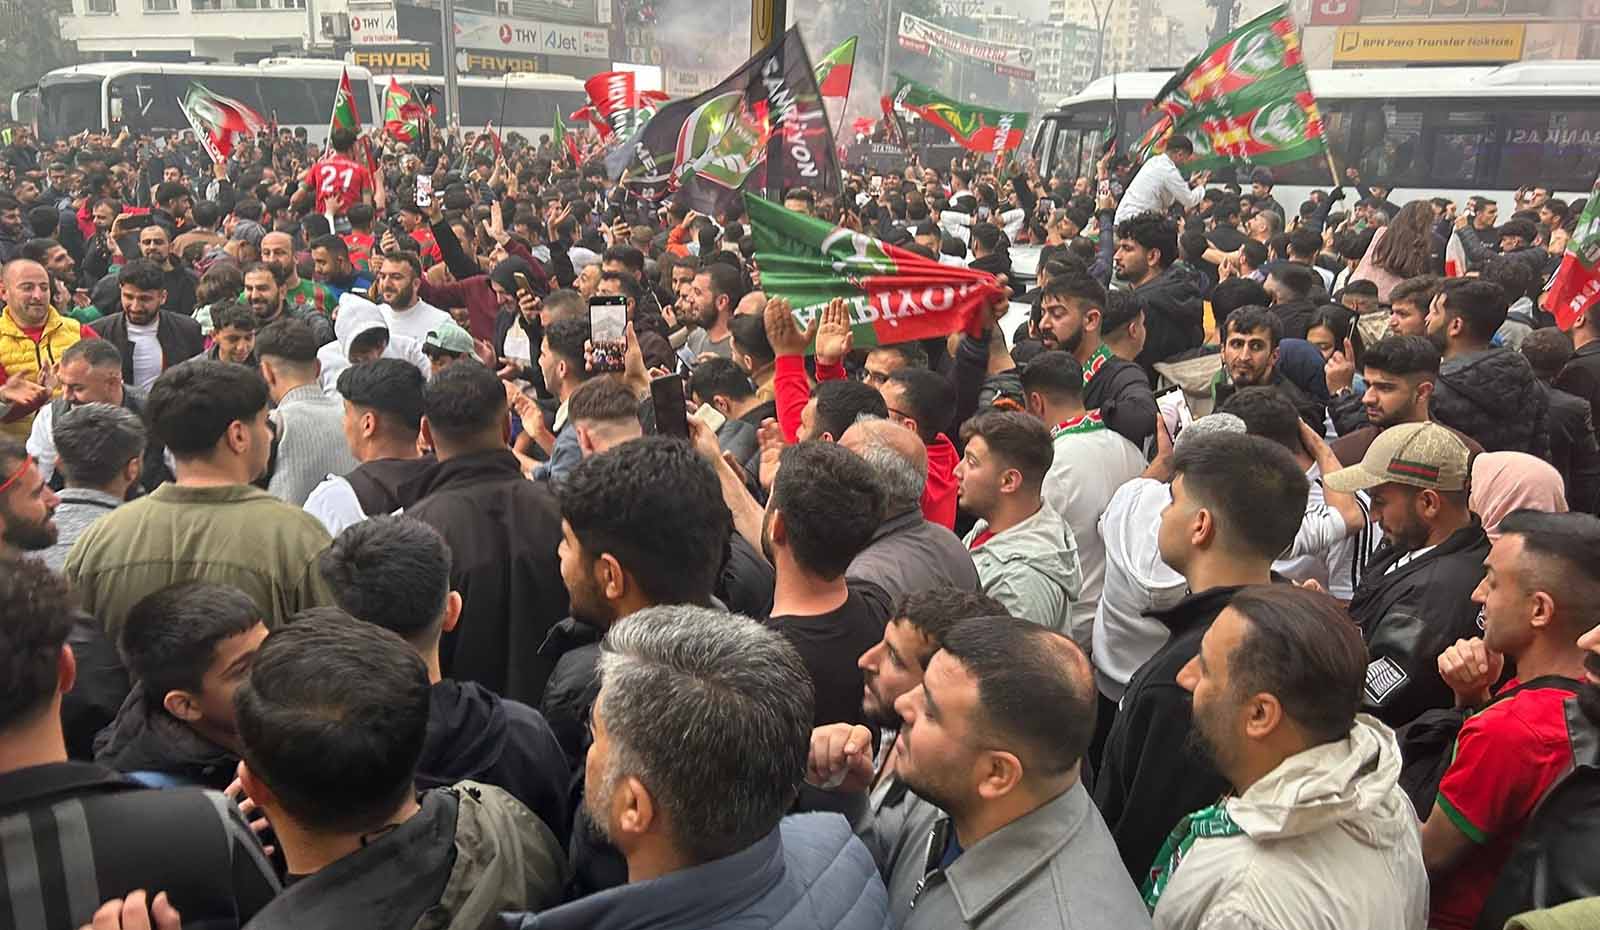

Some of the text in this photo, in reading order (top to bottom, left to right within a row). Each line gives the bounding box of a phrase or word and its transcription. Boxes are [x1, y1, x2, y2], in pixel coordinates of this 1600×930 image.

[362, 17, 379, 29] THY
[515, 29, 537, 43] THY
[545, 30, 577, 50] AJet
[1417, 37, 1465, 47] Transfer
[320, 165, 354, 192] 21
